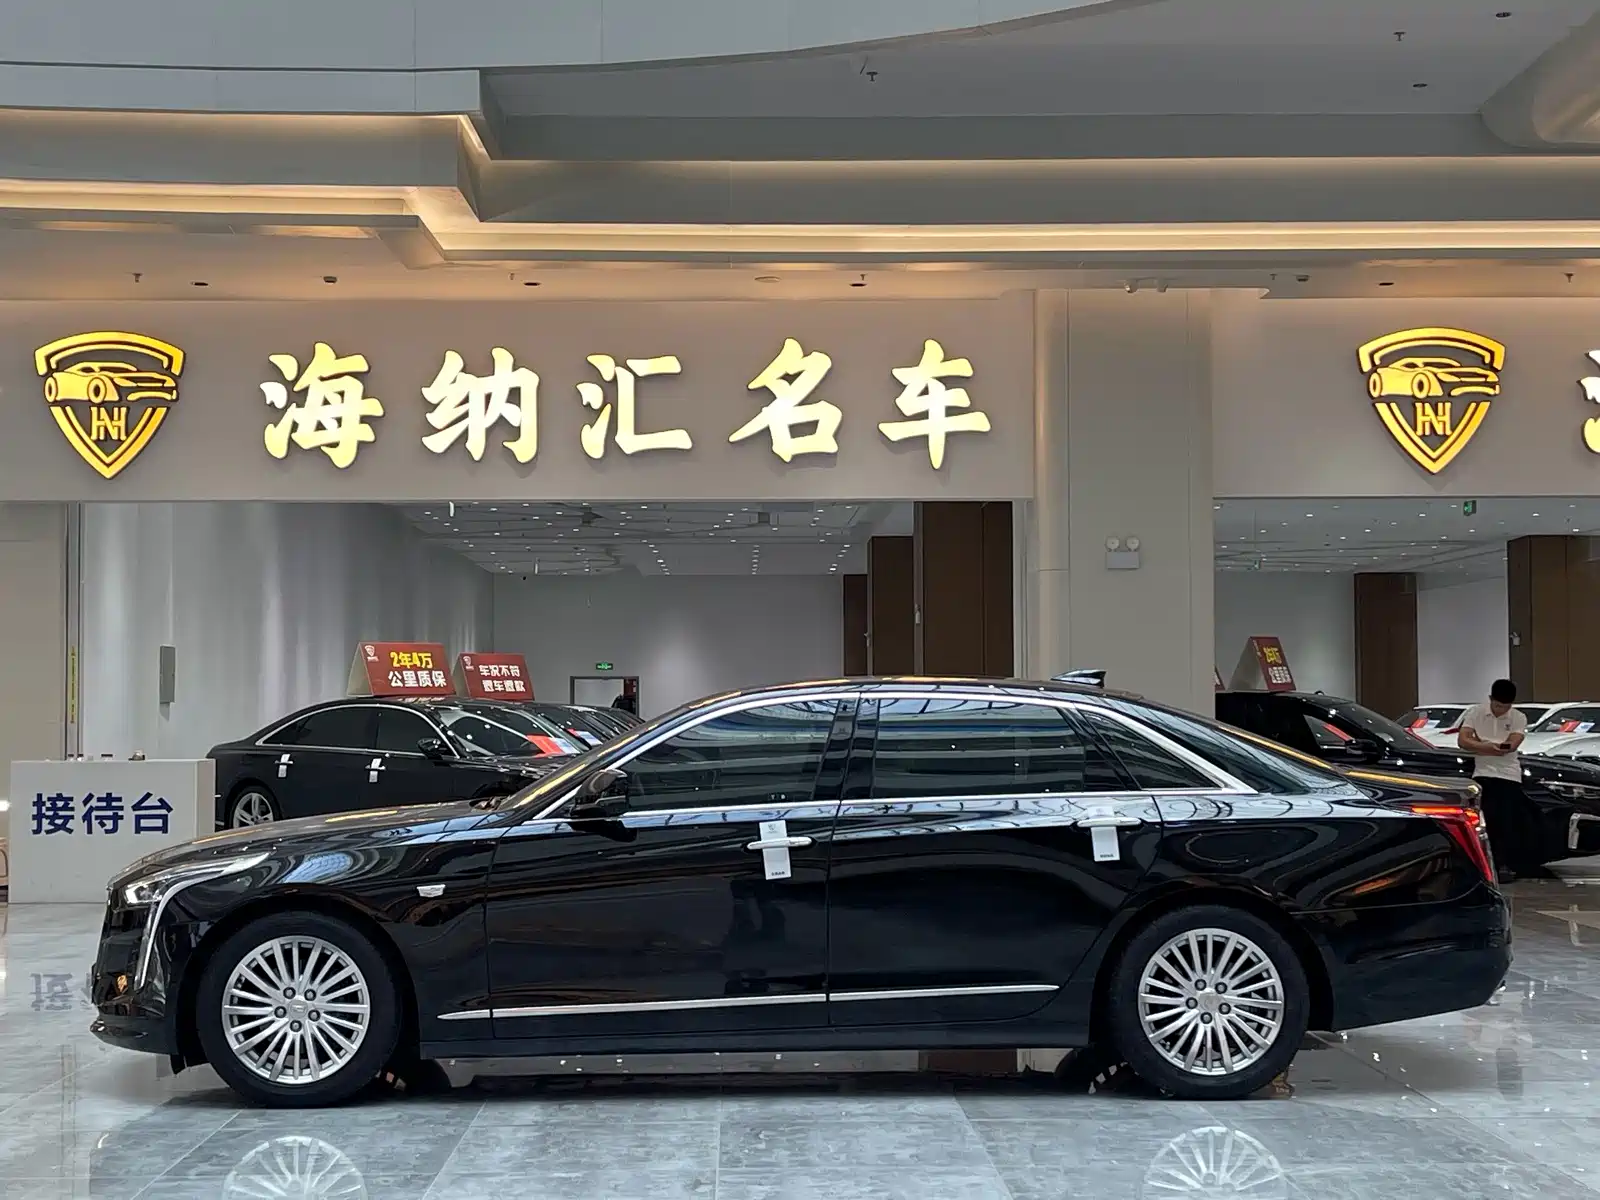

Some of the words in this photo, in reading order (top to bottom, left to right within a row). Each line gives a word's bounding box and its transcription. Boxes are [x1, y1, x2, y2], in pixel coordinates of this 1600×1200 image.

[259, 337, 992, 469] 海纳汇名车
[390, 651, 434, 669] 2年4万
[388, 670, 447, 688] 公里质保
[479, 664, 521, 678] 车况不符
[31, 792, 174, 835] 接待台
